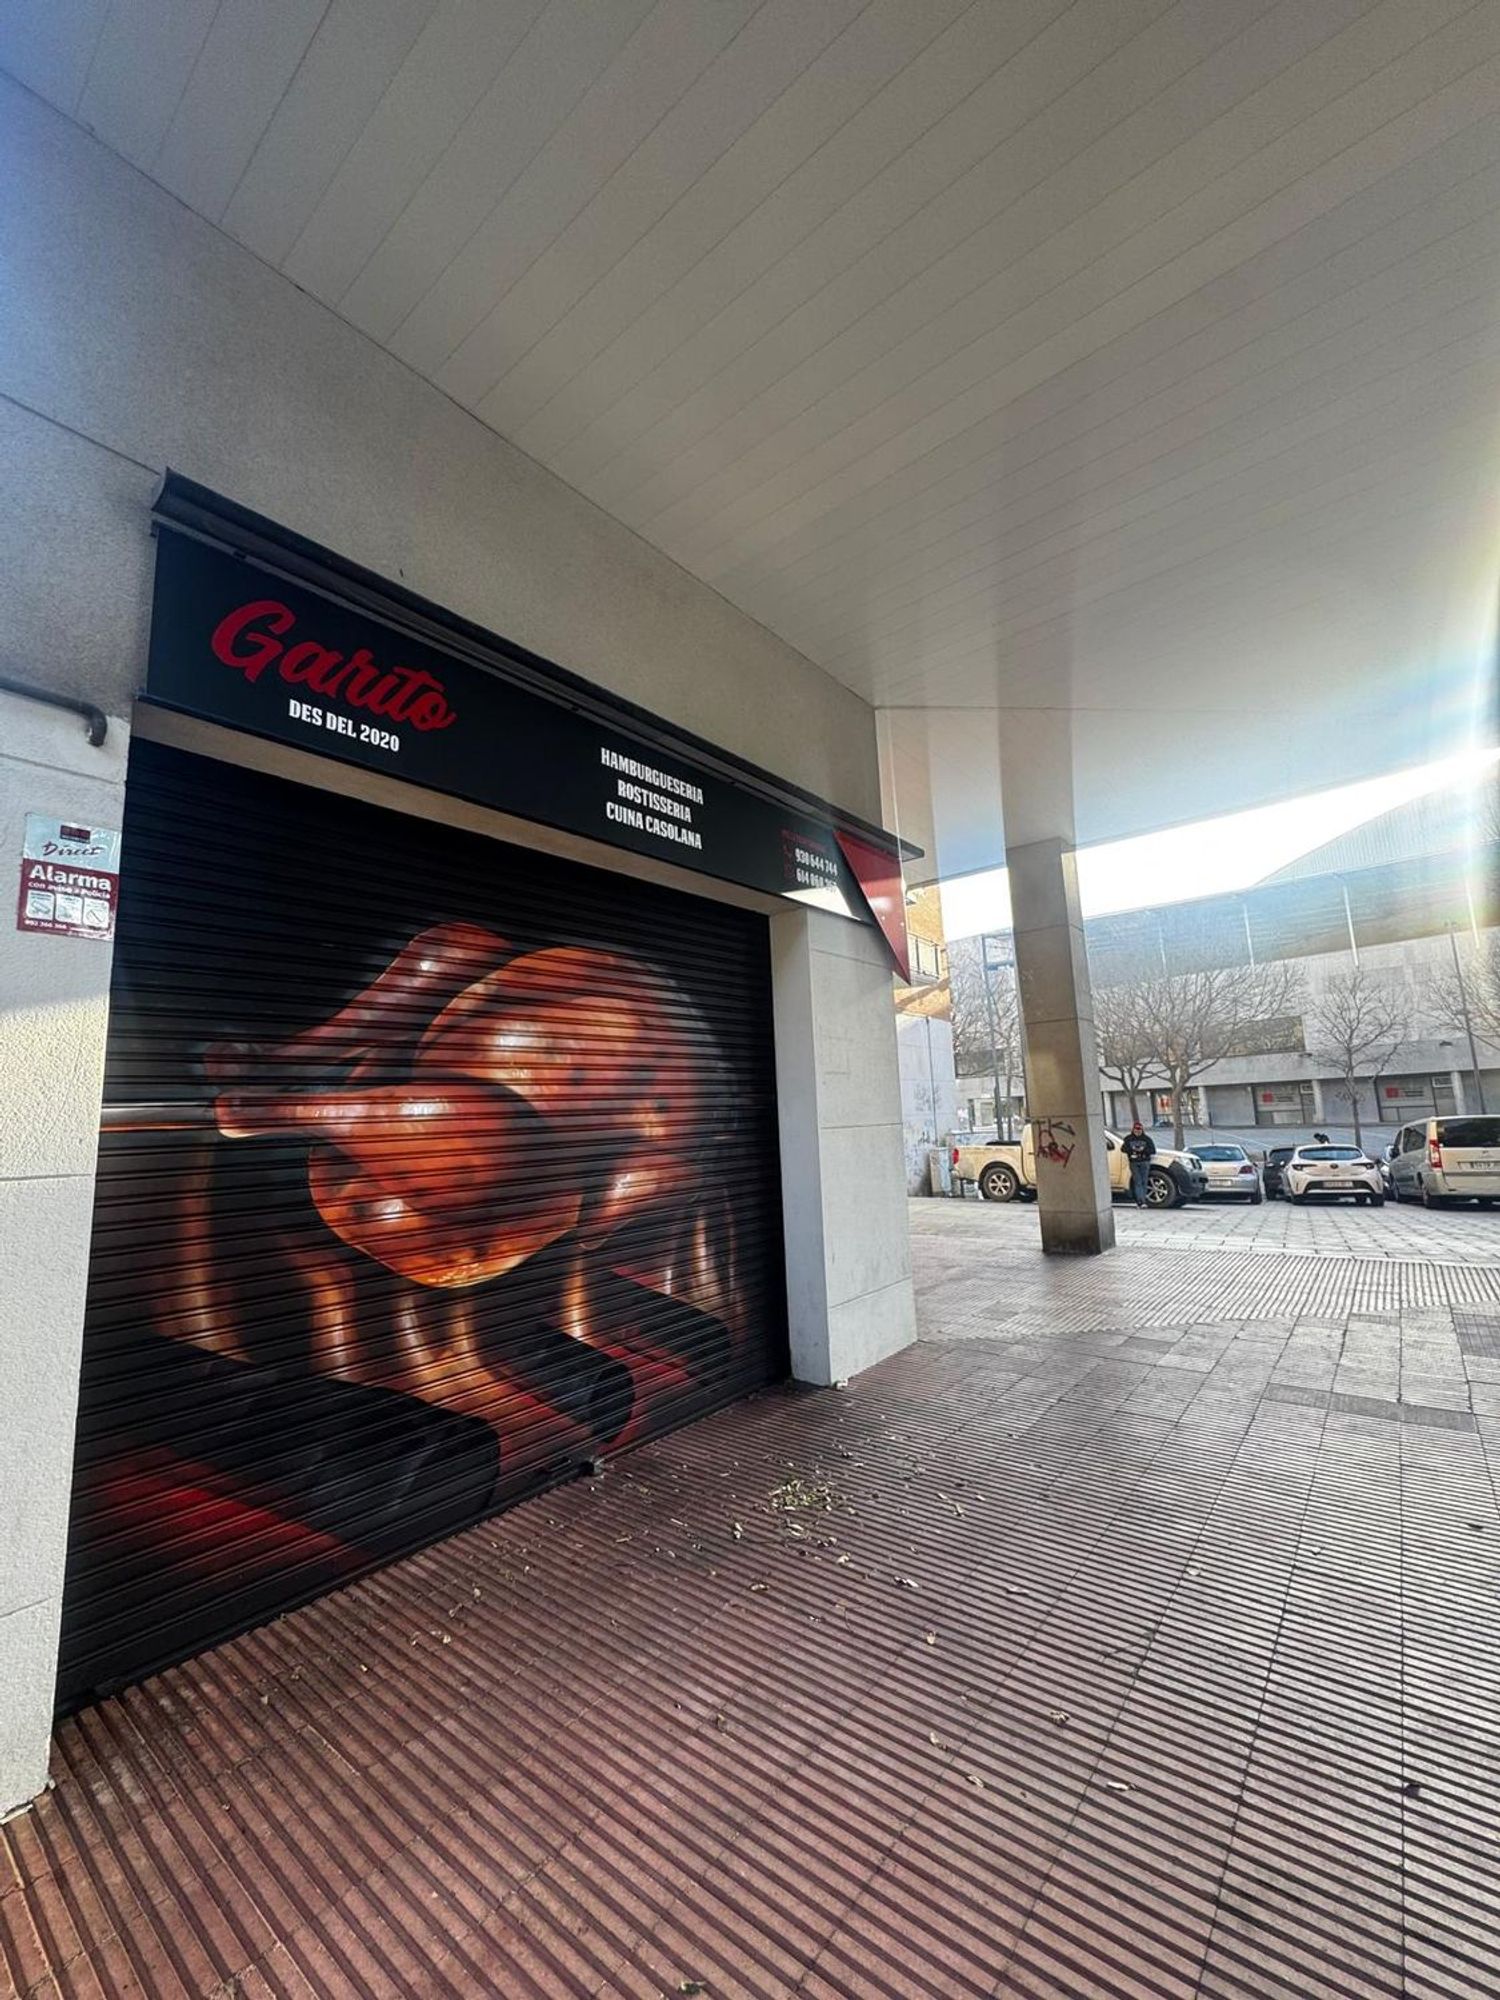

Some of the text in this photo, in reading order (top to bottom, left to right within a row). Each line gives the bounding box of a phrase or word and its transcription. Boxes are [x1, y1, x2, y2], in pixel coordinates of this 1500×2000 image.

[211, 600, 457, 732] Garito
[289, 699, 400, 752] DES DEL 2020
[601, 747, 704, 805] HAMBURGUESERIA
[617, 779, 692, 823] ROSTISSERIA
[606, 801, 703, 850] CUINA CASOLANA
[29, 864, 112, 892] Alarma
